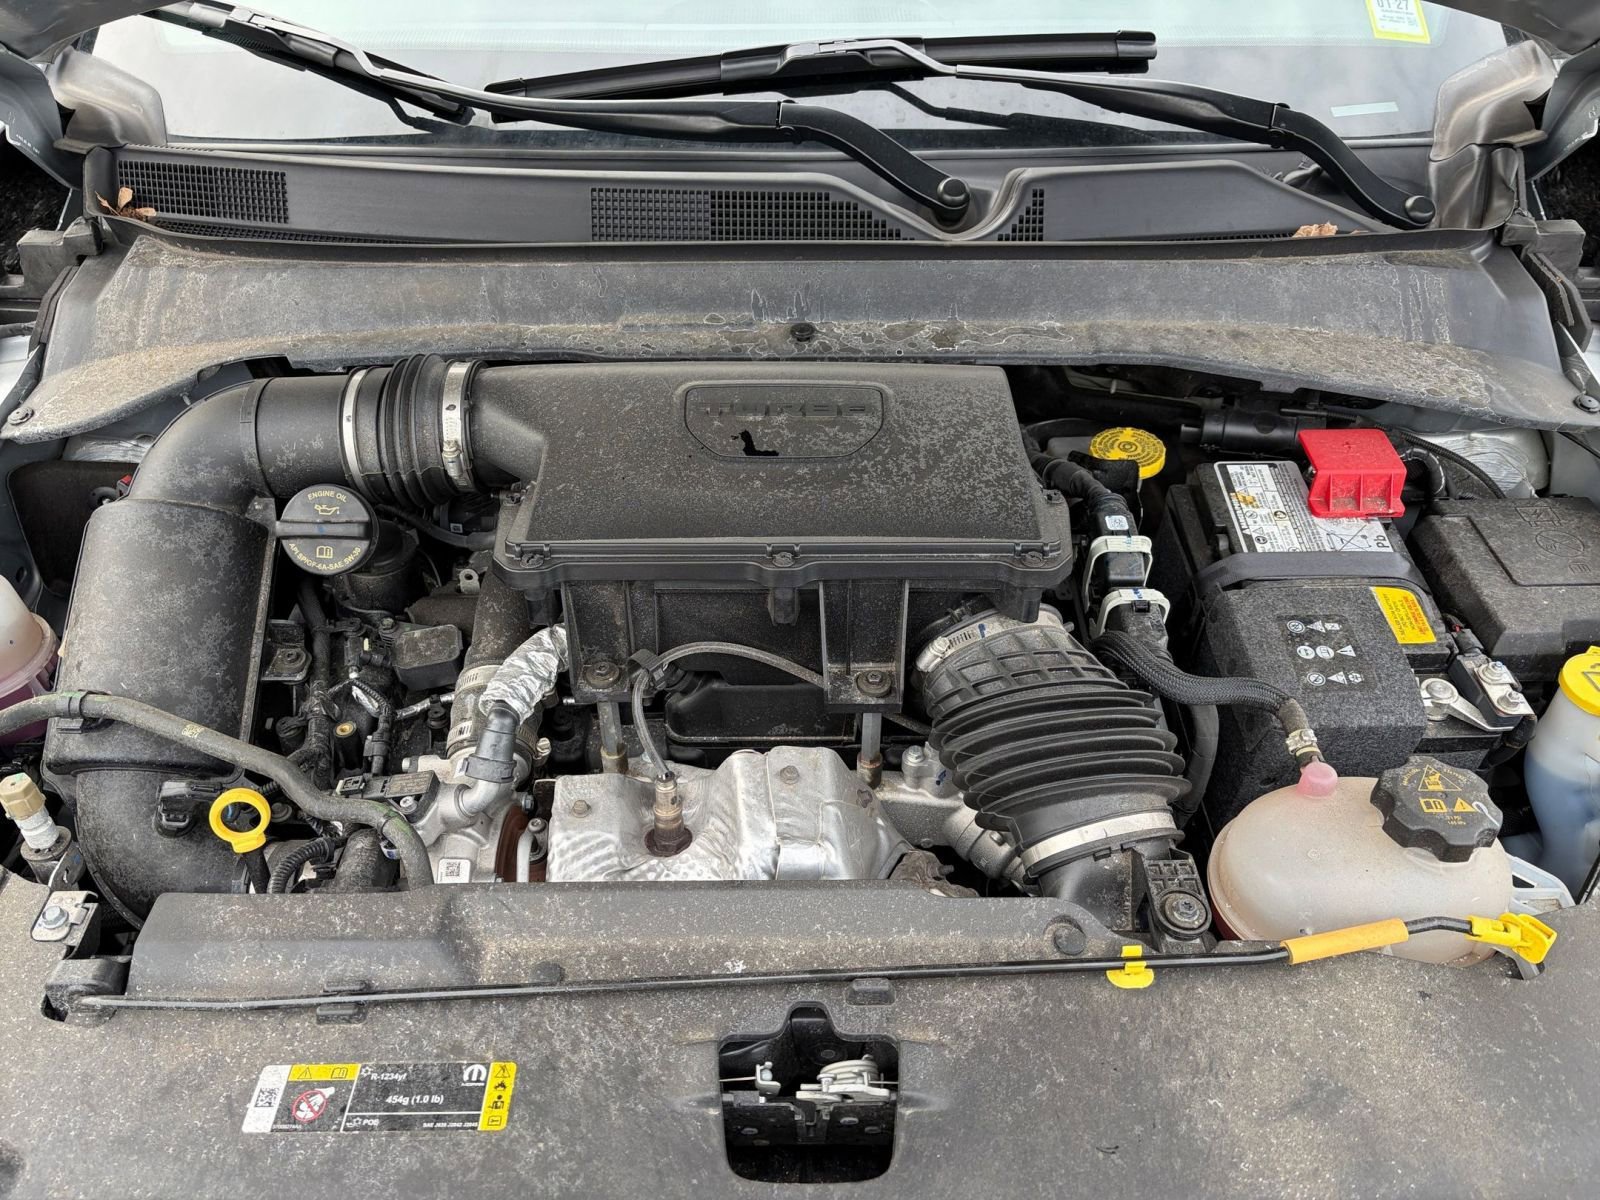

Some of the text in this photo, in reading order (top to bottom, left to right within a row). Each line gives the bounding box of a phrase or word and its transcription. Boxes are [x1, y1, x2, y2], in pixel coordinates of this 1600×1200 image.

[307, 490, 347, 502] ENGINE OIL
[1374, 534, 1389, 548] Pb
[289, 543, 299, 554] API
[343, 546, 361, 564] 5W-30
[371, 1073, 407, 1081] R-1234yf
[385, 1095, 444, 1105] 454g (1.0 lb)
